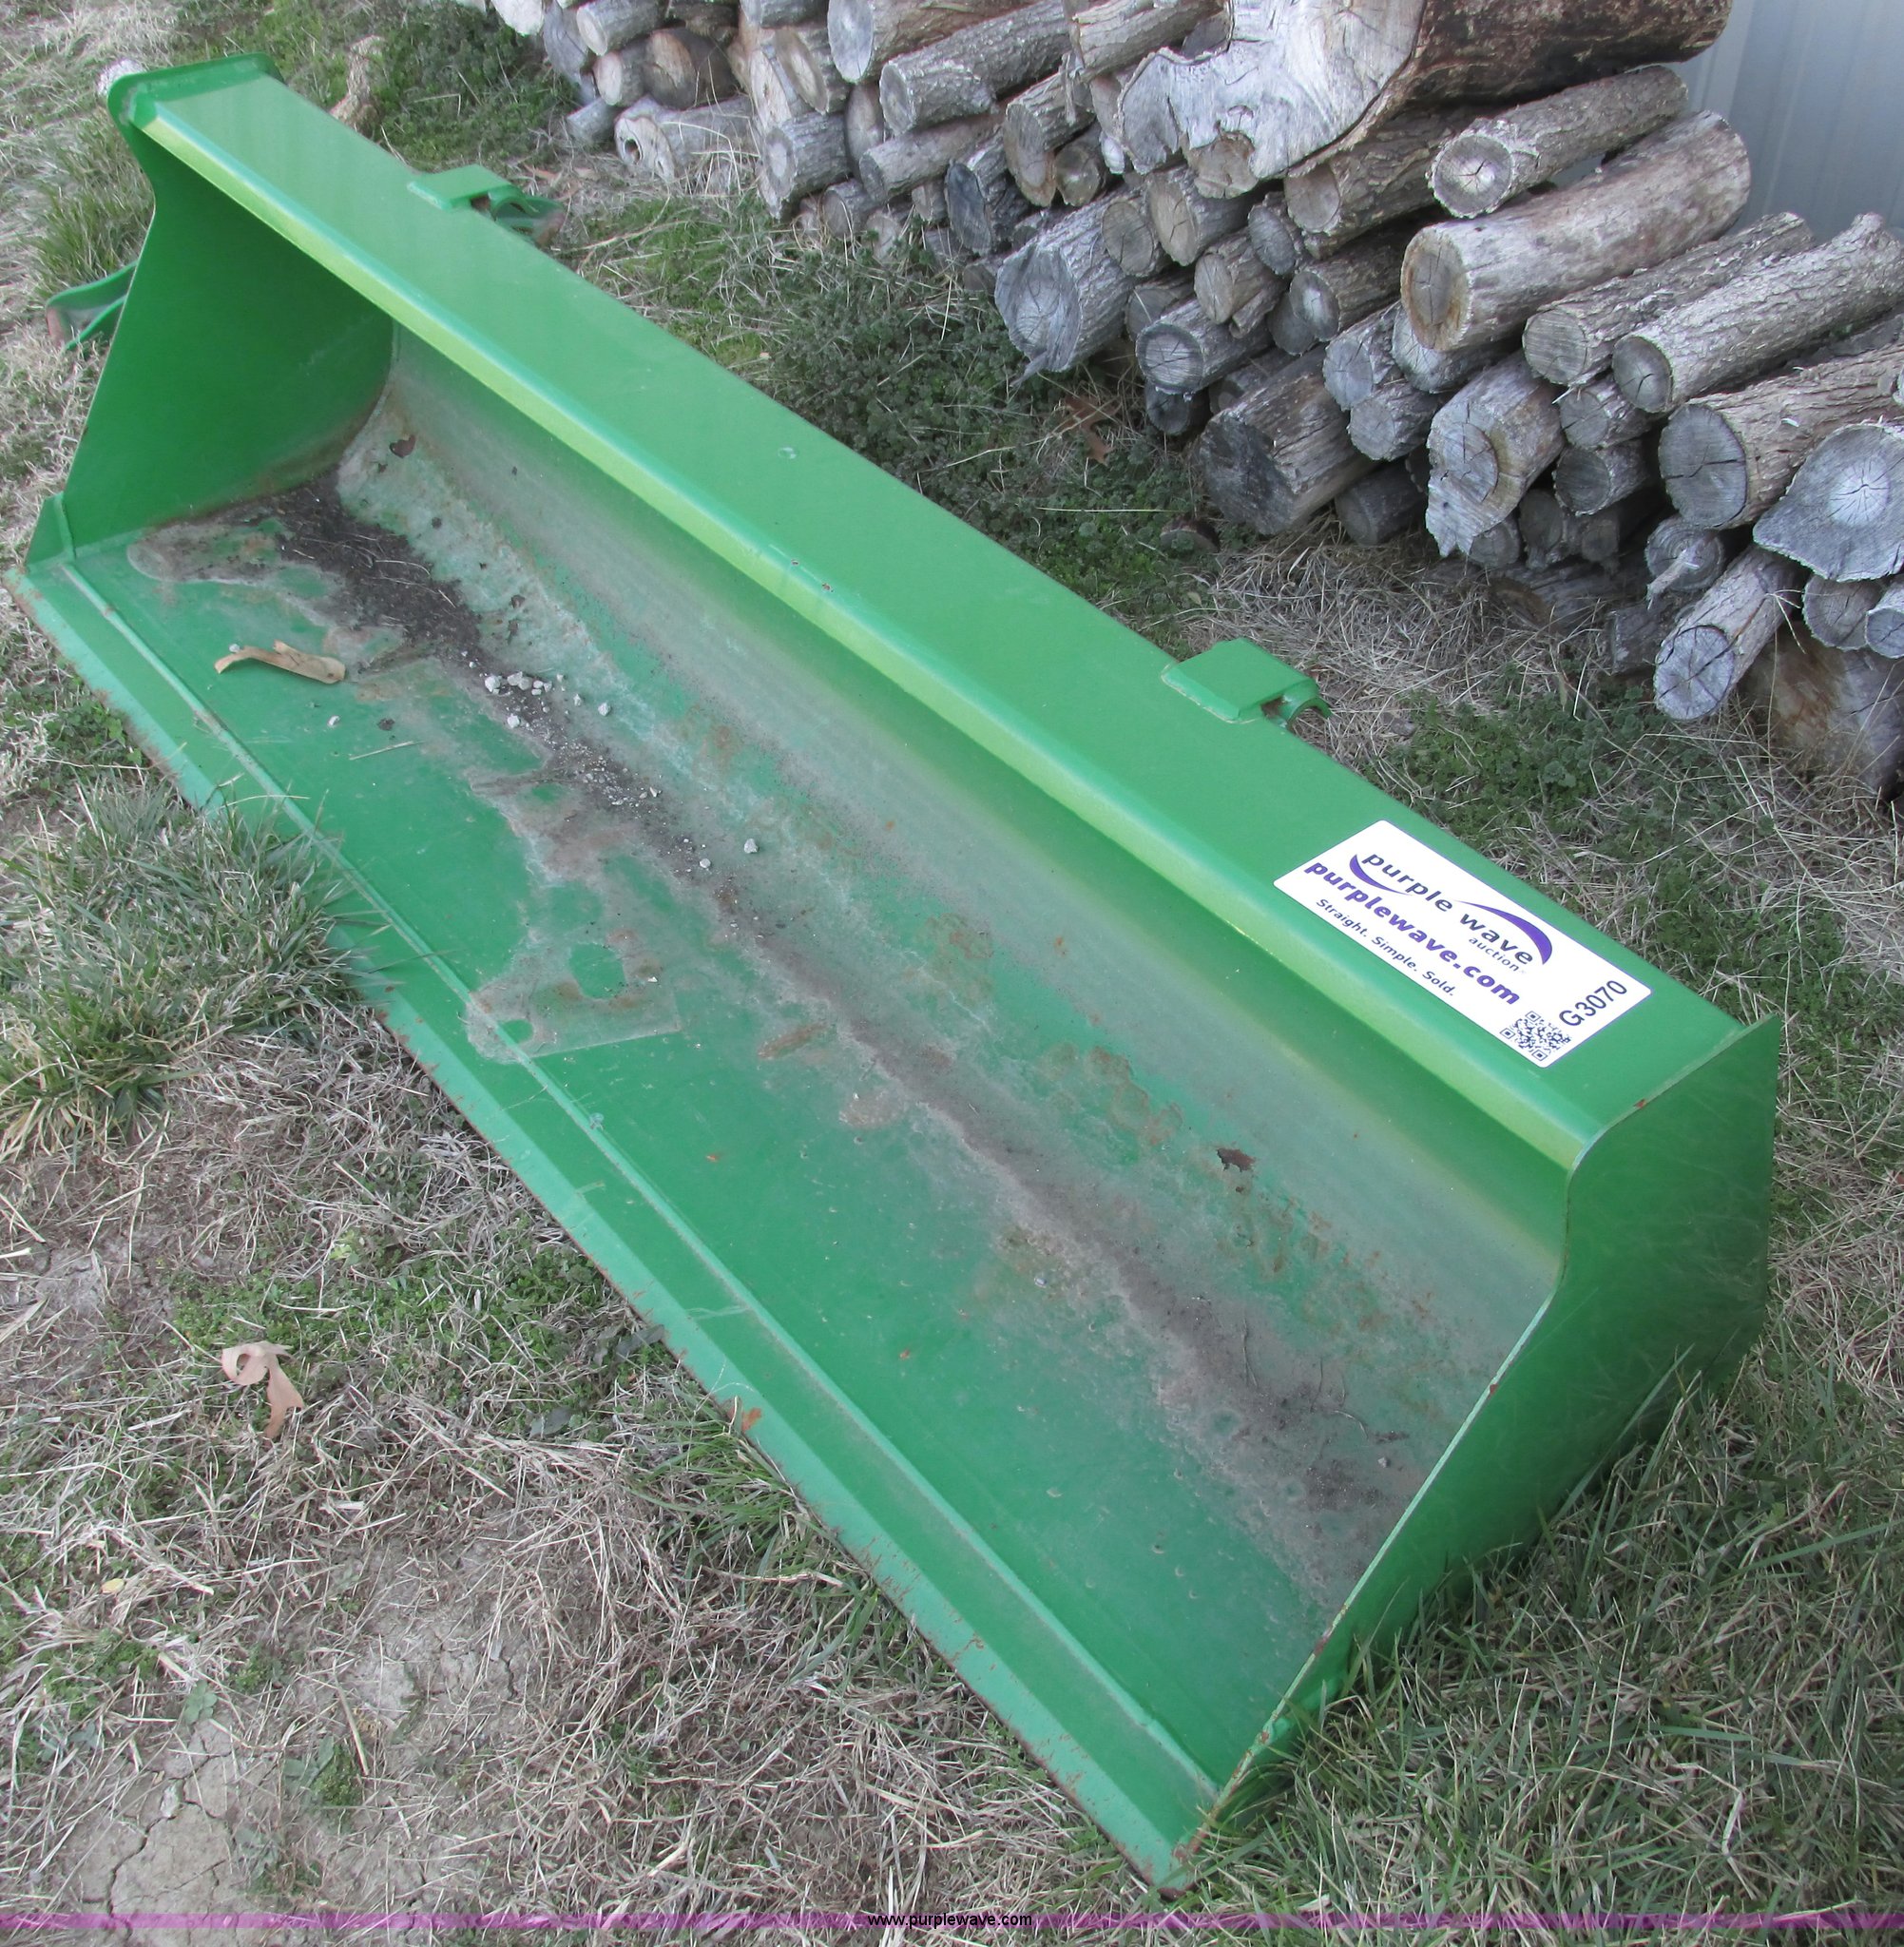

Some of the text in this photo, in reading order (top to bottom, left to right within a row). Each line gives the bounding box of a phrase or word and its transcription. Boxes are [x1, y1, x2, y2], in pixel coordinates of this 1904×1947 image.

[1304, 861, 1520, 1005] purplewave.com
[1316, 898, 1455, 996] Straight. Simple. Sold.
[1362, 853, 1533, 965] purple wave
[1469, 936, 1519, 972] auction
[1558, 979, 1628, 1027] G3070
